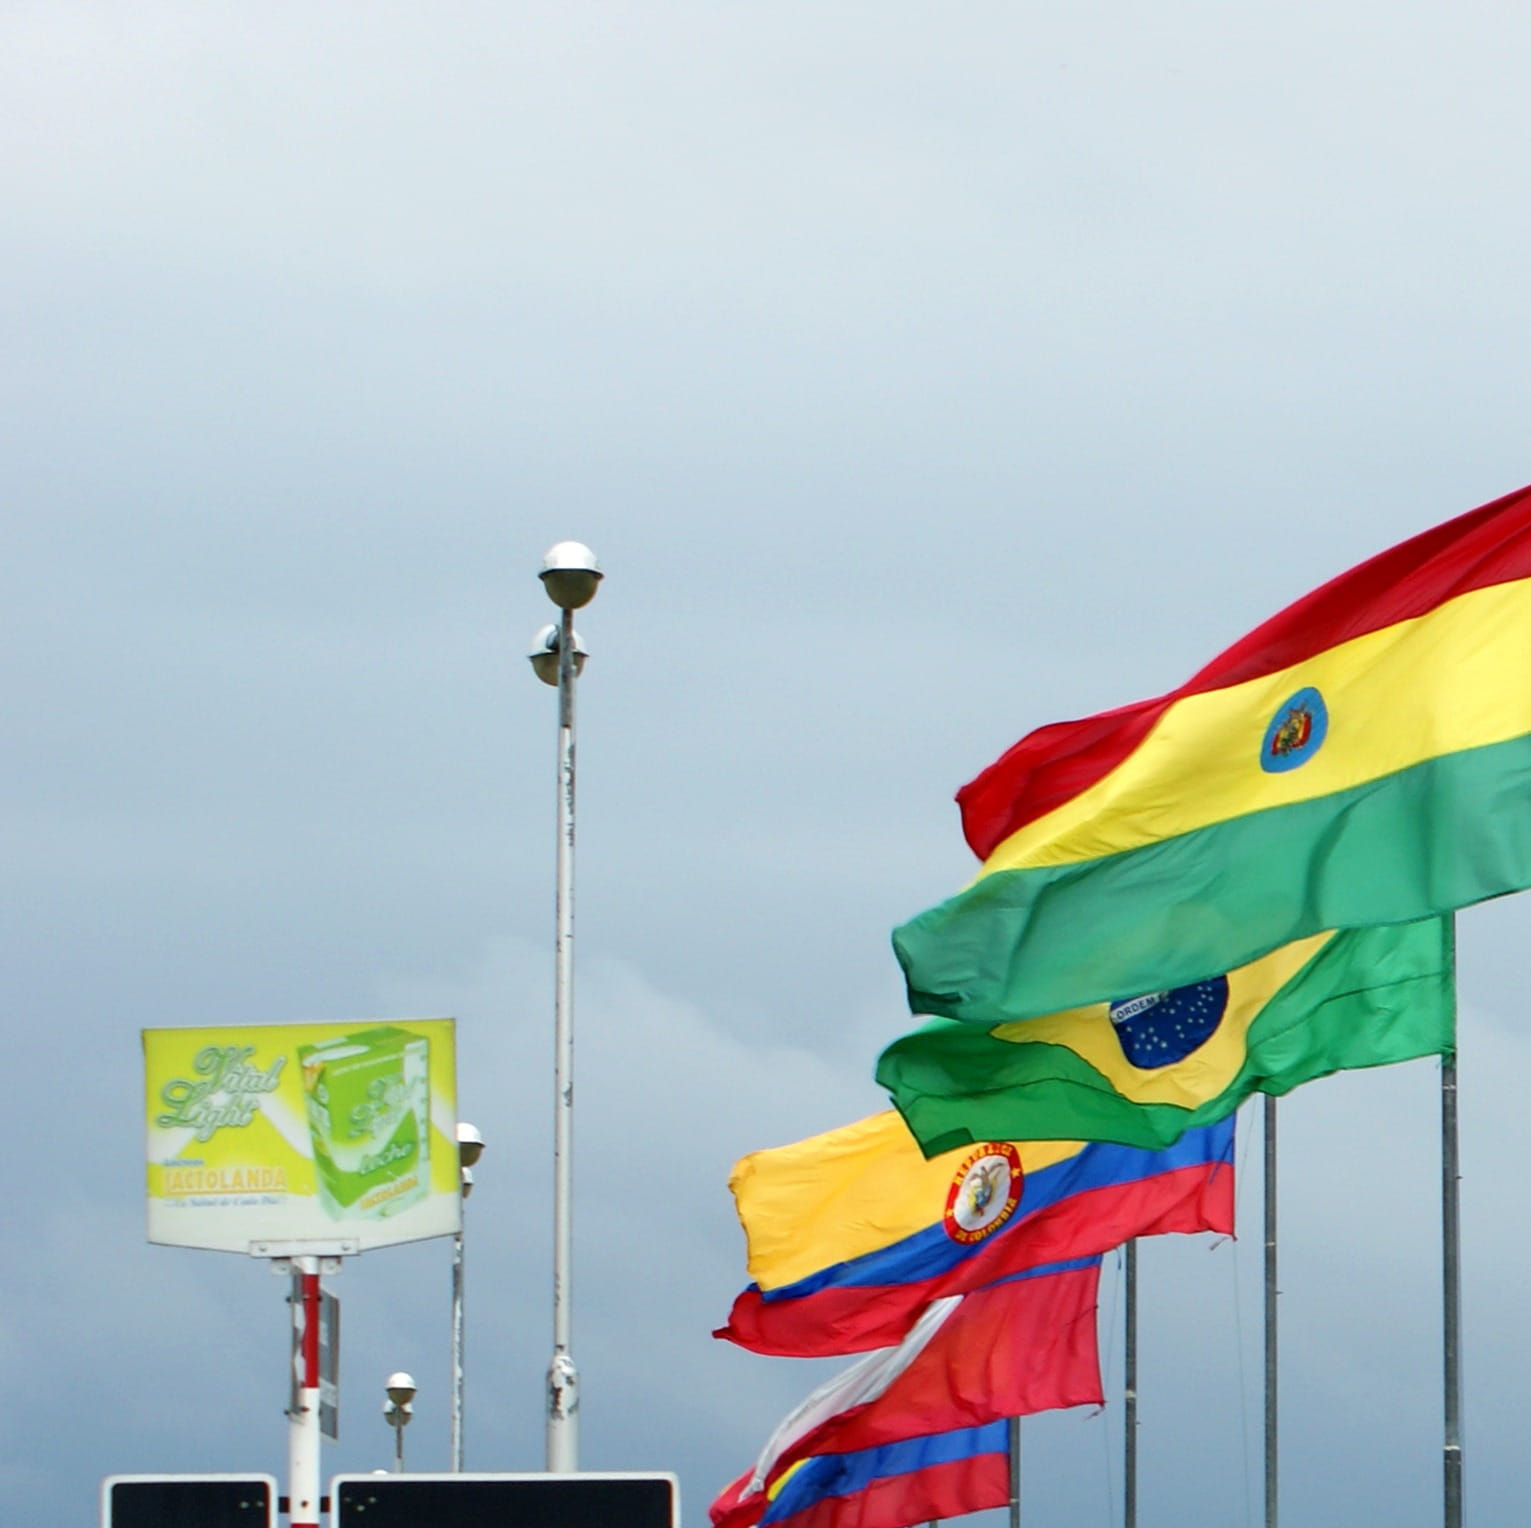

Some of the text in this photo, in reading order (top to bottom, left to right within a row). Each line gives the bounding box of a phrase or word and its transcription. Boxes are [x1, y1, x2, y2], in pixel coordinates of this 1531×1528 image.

[1116, 996, 1155, 1020] ORDEM
[193, 1044, 287, 1094] Vital
[156, 1079, 260, 1143] Light
[163, 1167, 287, 1195] LACTOLANDA
